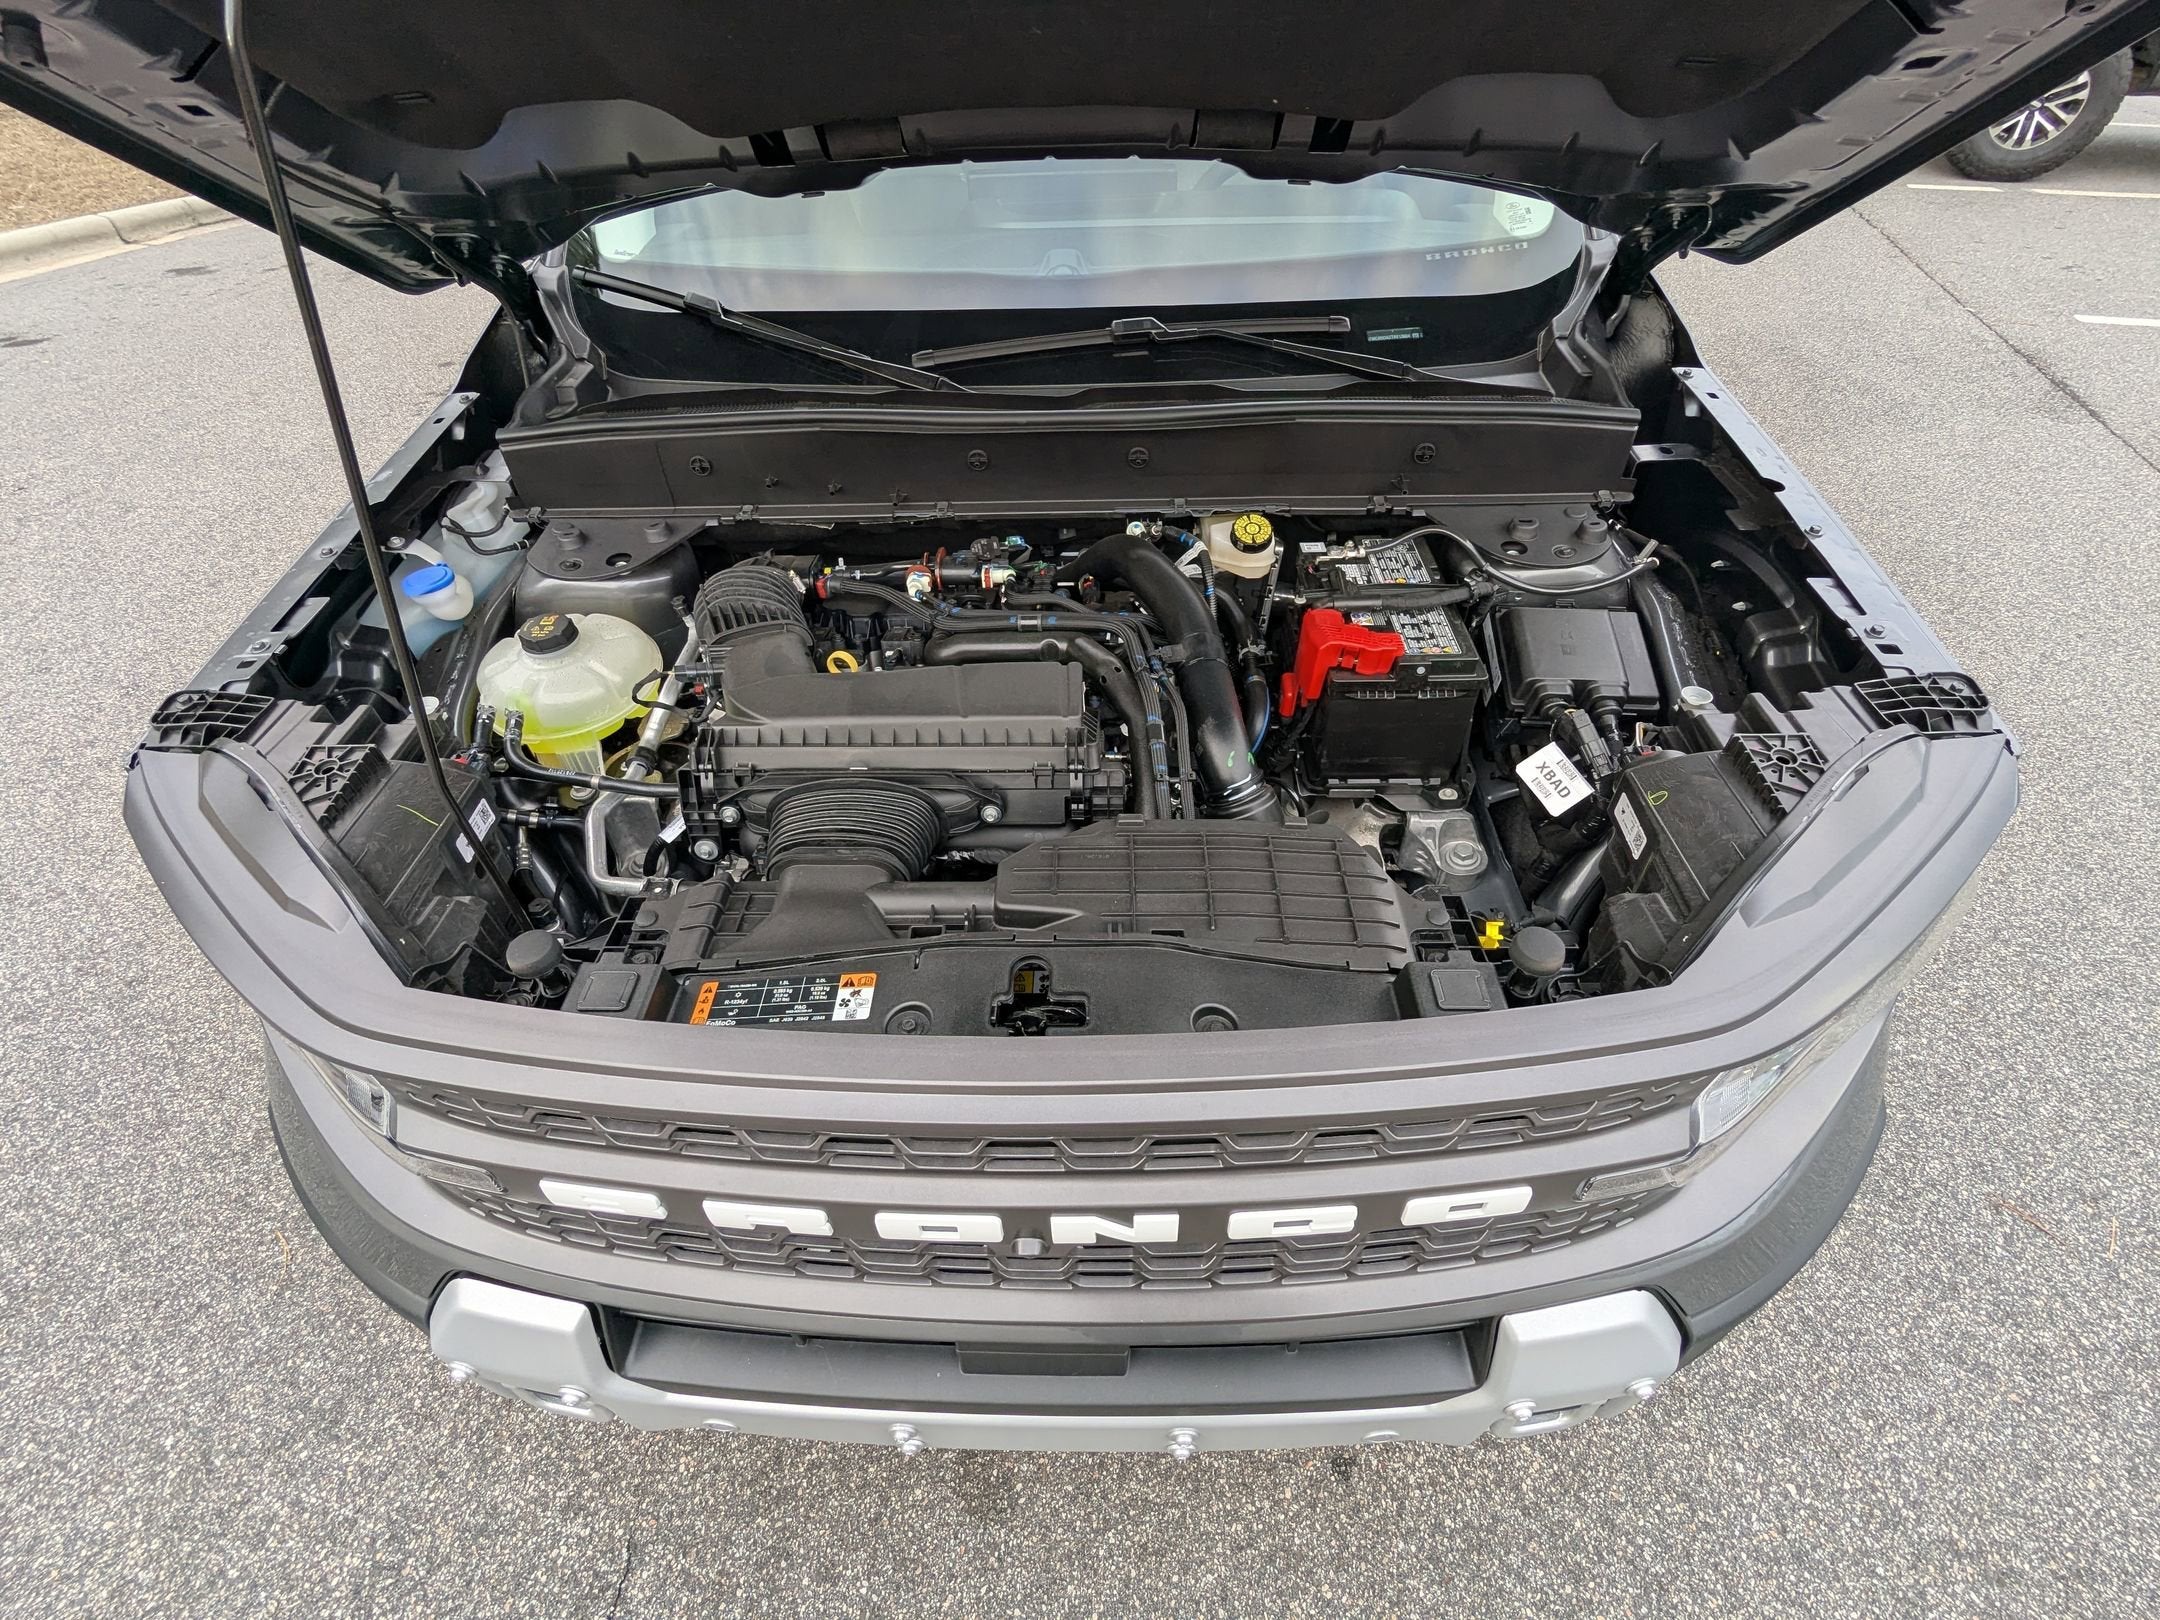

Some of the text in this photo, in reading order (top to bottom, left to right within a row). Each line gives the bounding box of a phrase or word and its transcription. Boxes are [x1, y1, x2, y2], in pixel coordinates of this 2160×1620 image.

[1425, 241, 1529, 261] BRONCO
[1536, 761, 1571, 798] XBAD
[538, 1178, 1534, 1244] BRONCO
